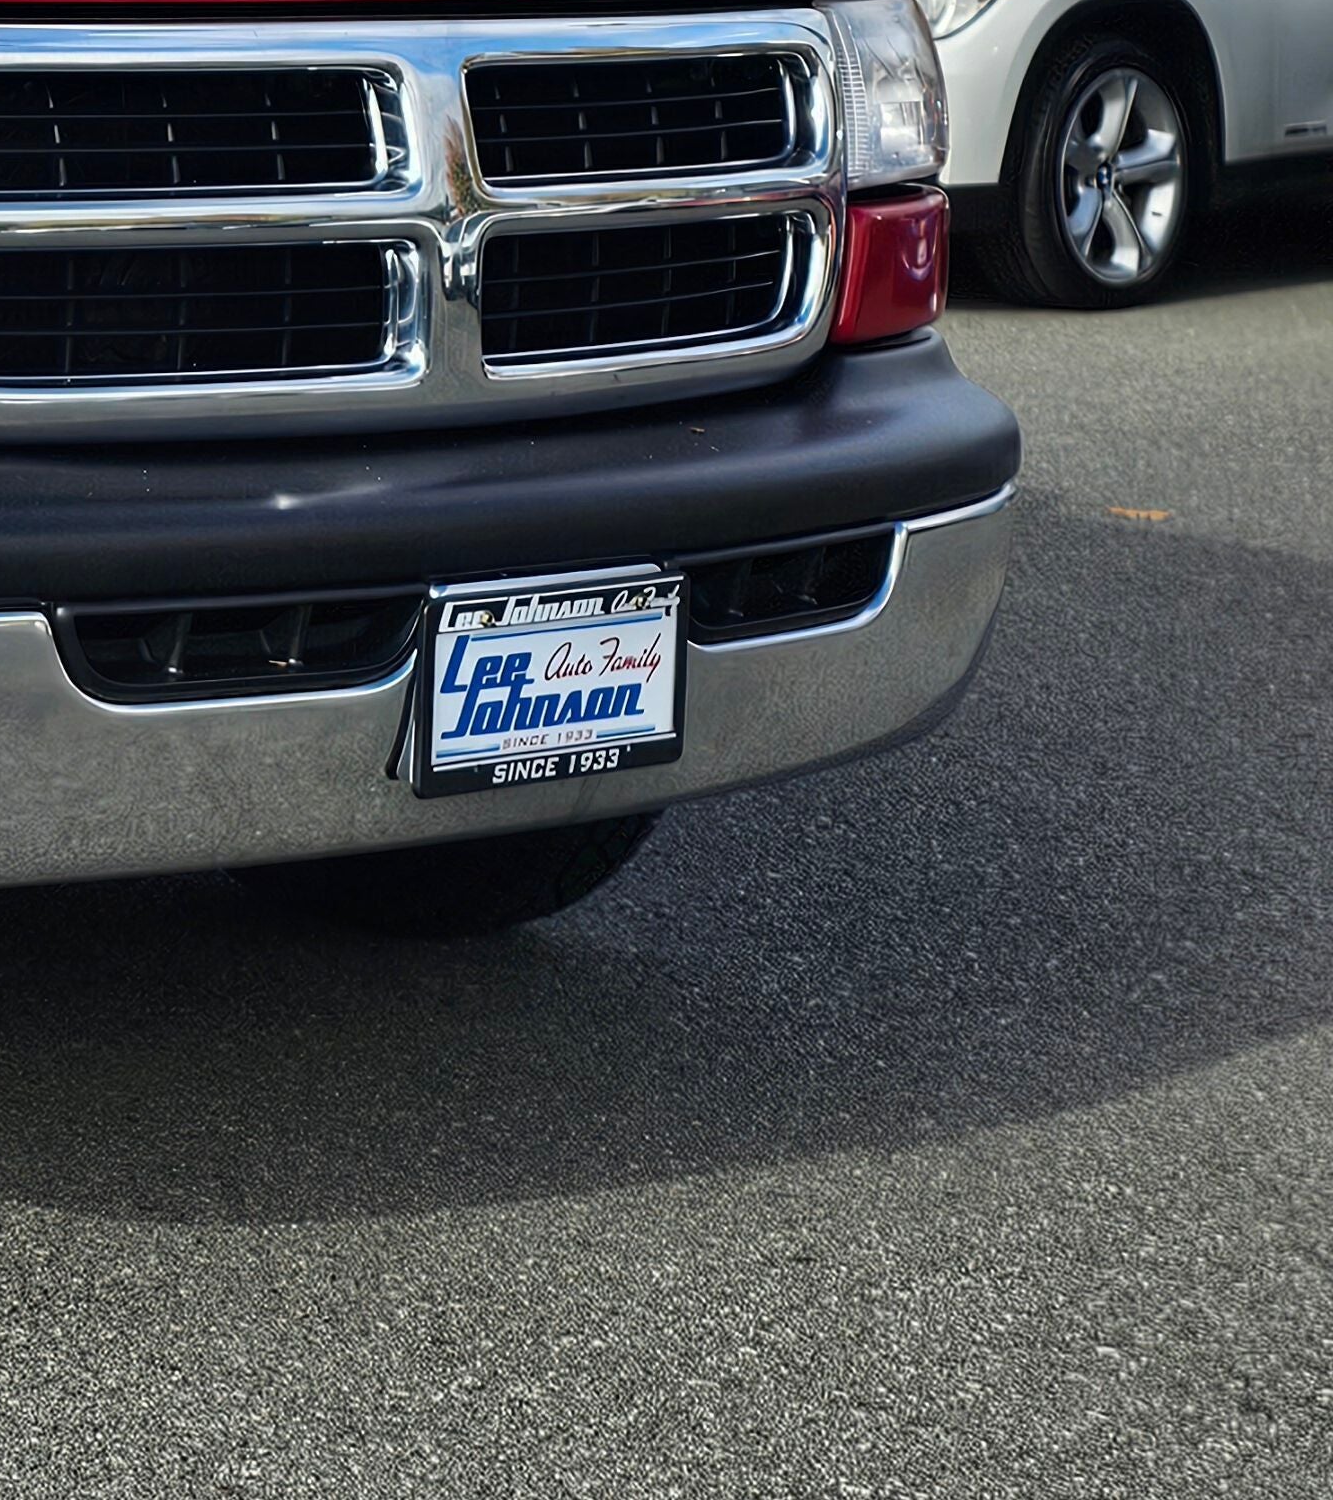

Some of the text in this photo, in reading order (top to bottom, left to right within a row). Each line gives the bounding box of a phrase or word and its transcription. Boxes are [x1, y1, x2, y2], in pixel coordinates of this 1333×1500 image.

[440, 634, 534, 694] Lee
[544, 632, 662, 683] Auto Family
[440, 678, 645, 740] Johnson
[502, 729, 593, 750] SINCE 1933
[492, 748, 620, 784] SINCE 1933
